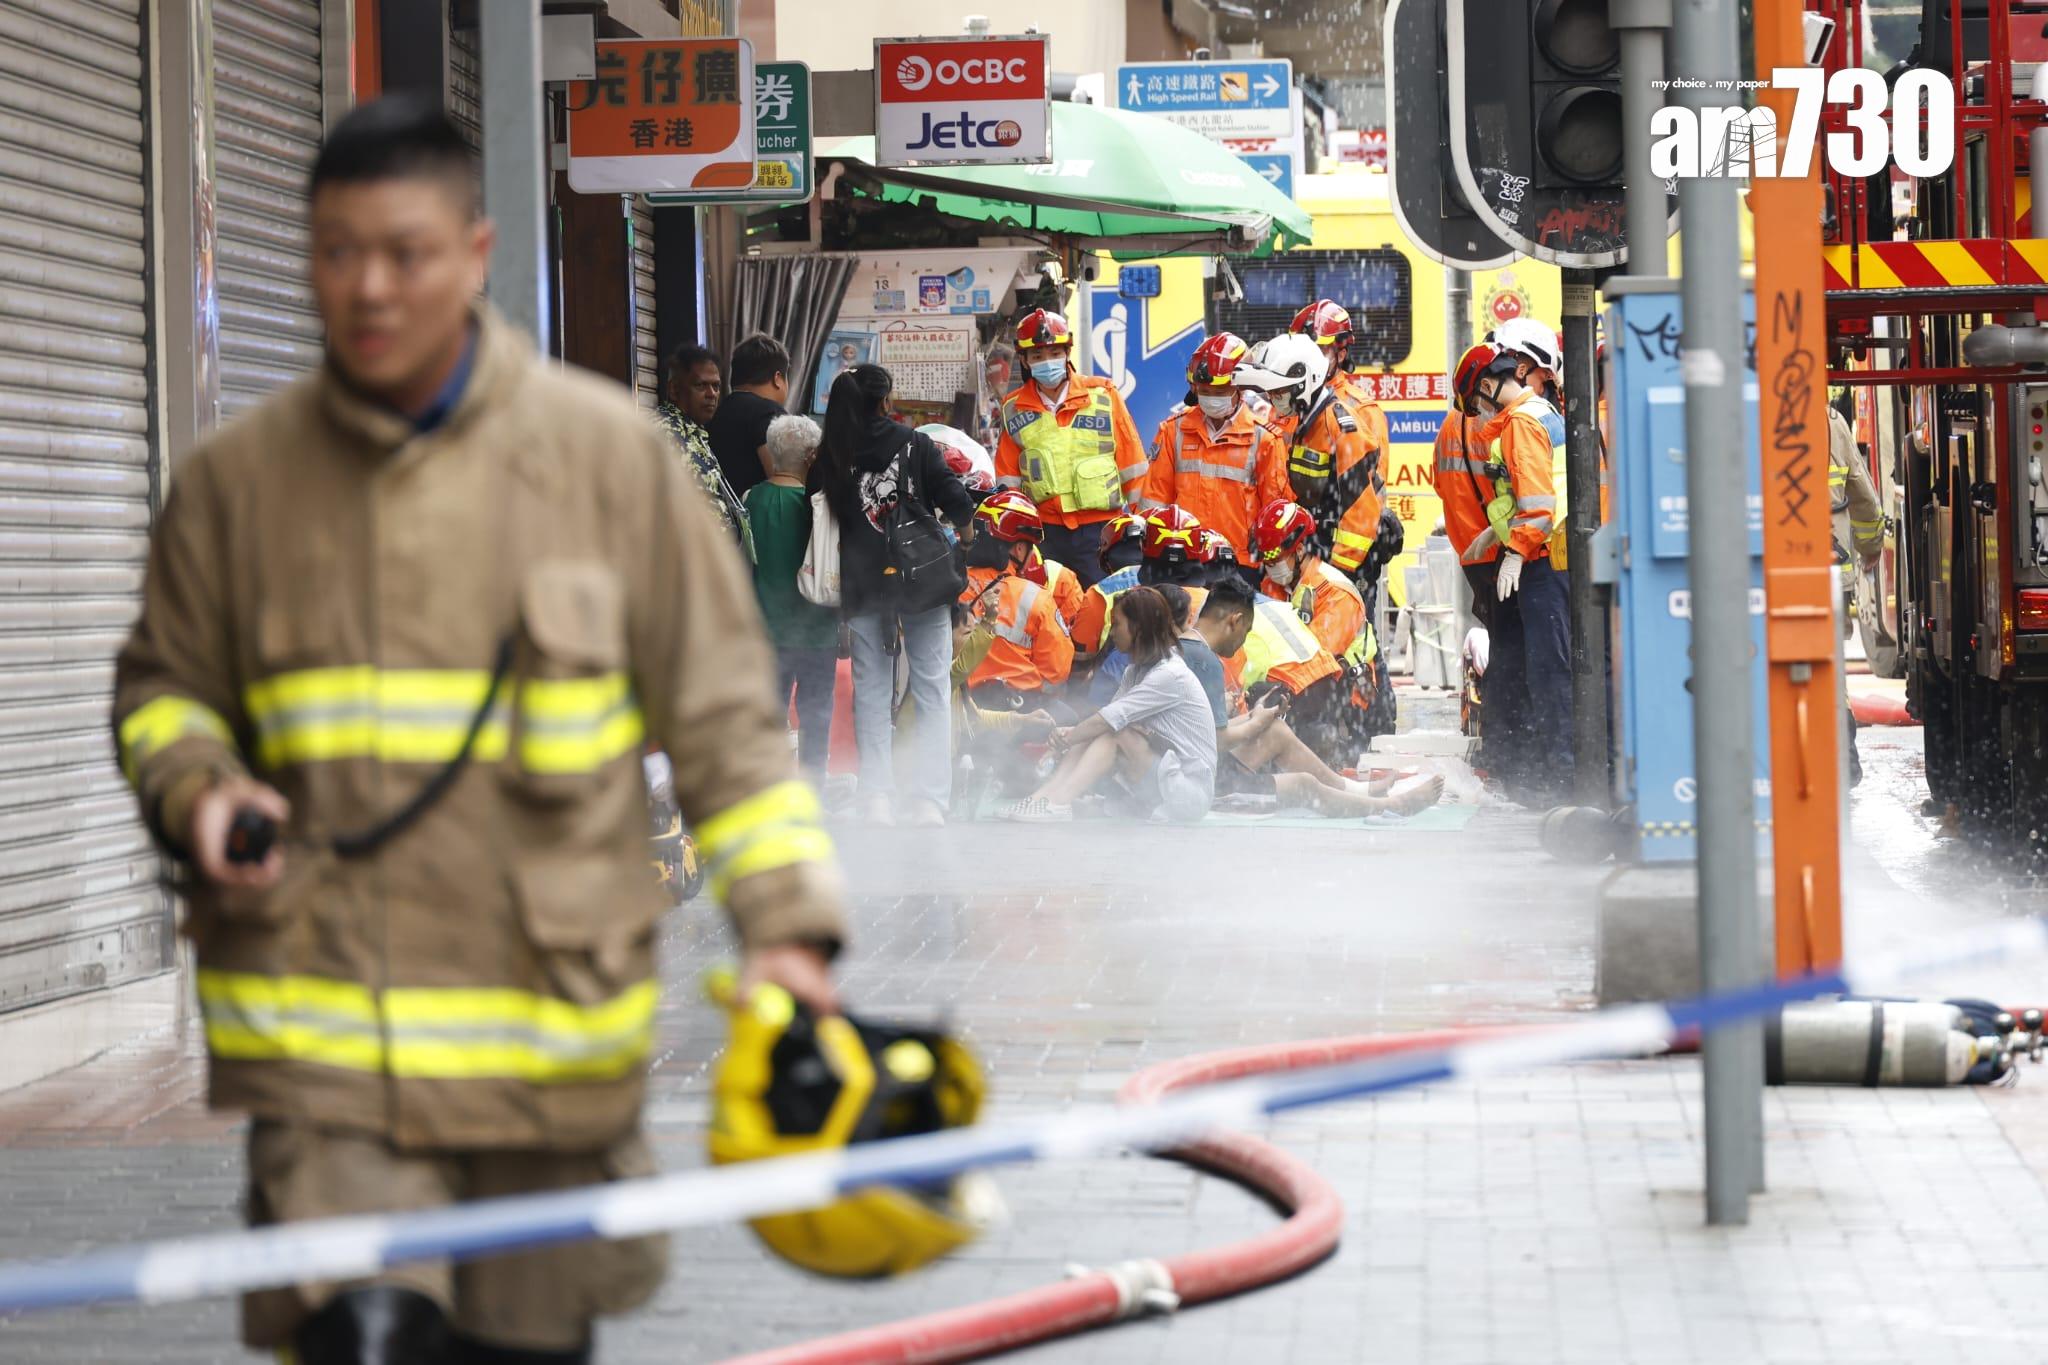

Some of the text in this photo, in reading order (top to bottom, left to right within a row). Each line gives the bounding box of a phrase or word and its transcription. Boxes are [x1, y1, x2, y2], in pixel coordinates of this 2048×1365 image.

[936, 57, 1026, 85] OCBC
[1147, 74, 1217, 92] 高速鐵路
[756, 73, 794, 121] 券
[1147, 92, 1217, 104] High Speed Rail
[629, 117, 694, 149] 香港
[757, 133, 797, 148] ucher
[1008, 411, 1036, 433] AMB
[1077, 415, 1106, 429] FSD
[1391, 421, 1440, 433] AMBUL
